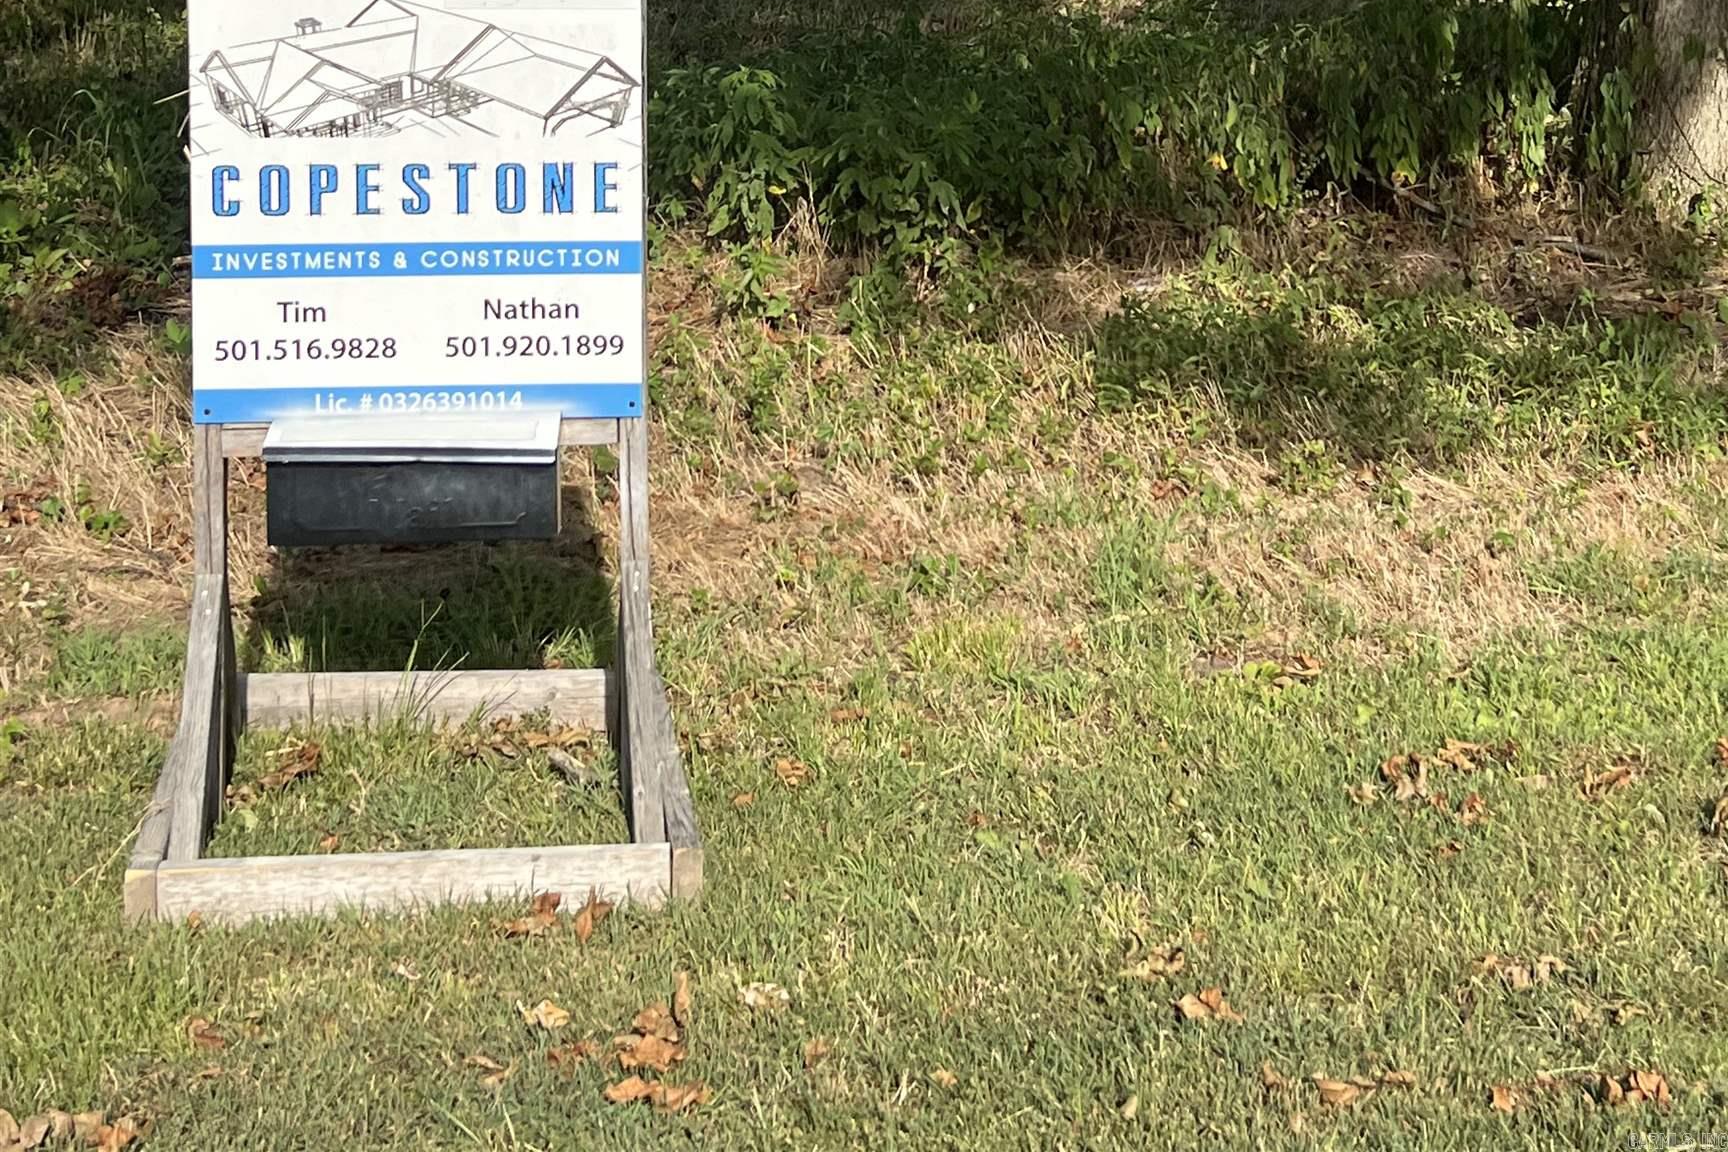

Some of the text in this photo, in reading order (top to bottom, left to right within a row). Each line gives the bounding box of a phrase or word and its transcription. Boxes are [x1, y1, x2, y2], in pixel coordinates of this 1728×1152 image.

[211, 161, 619, 216] COPESTONE
[211, 249, 621, 271] INVESTMENTS & CONSTRUCTION
[276, 301, 327, 323] Tim
[483, 298, 580, 320] Nathan
[214, 338, 397, 361] 501.516.9828
[445, 335, 625, 358] 501.920.1899
